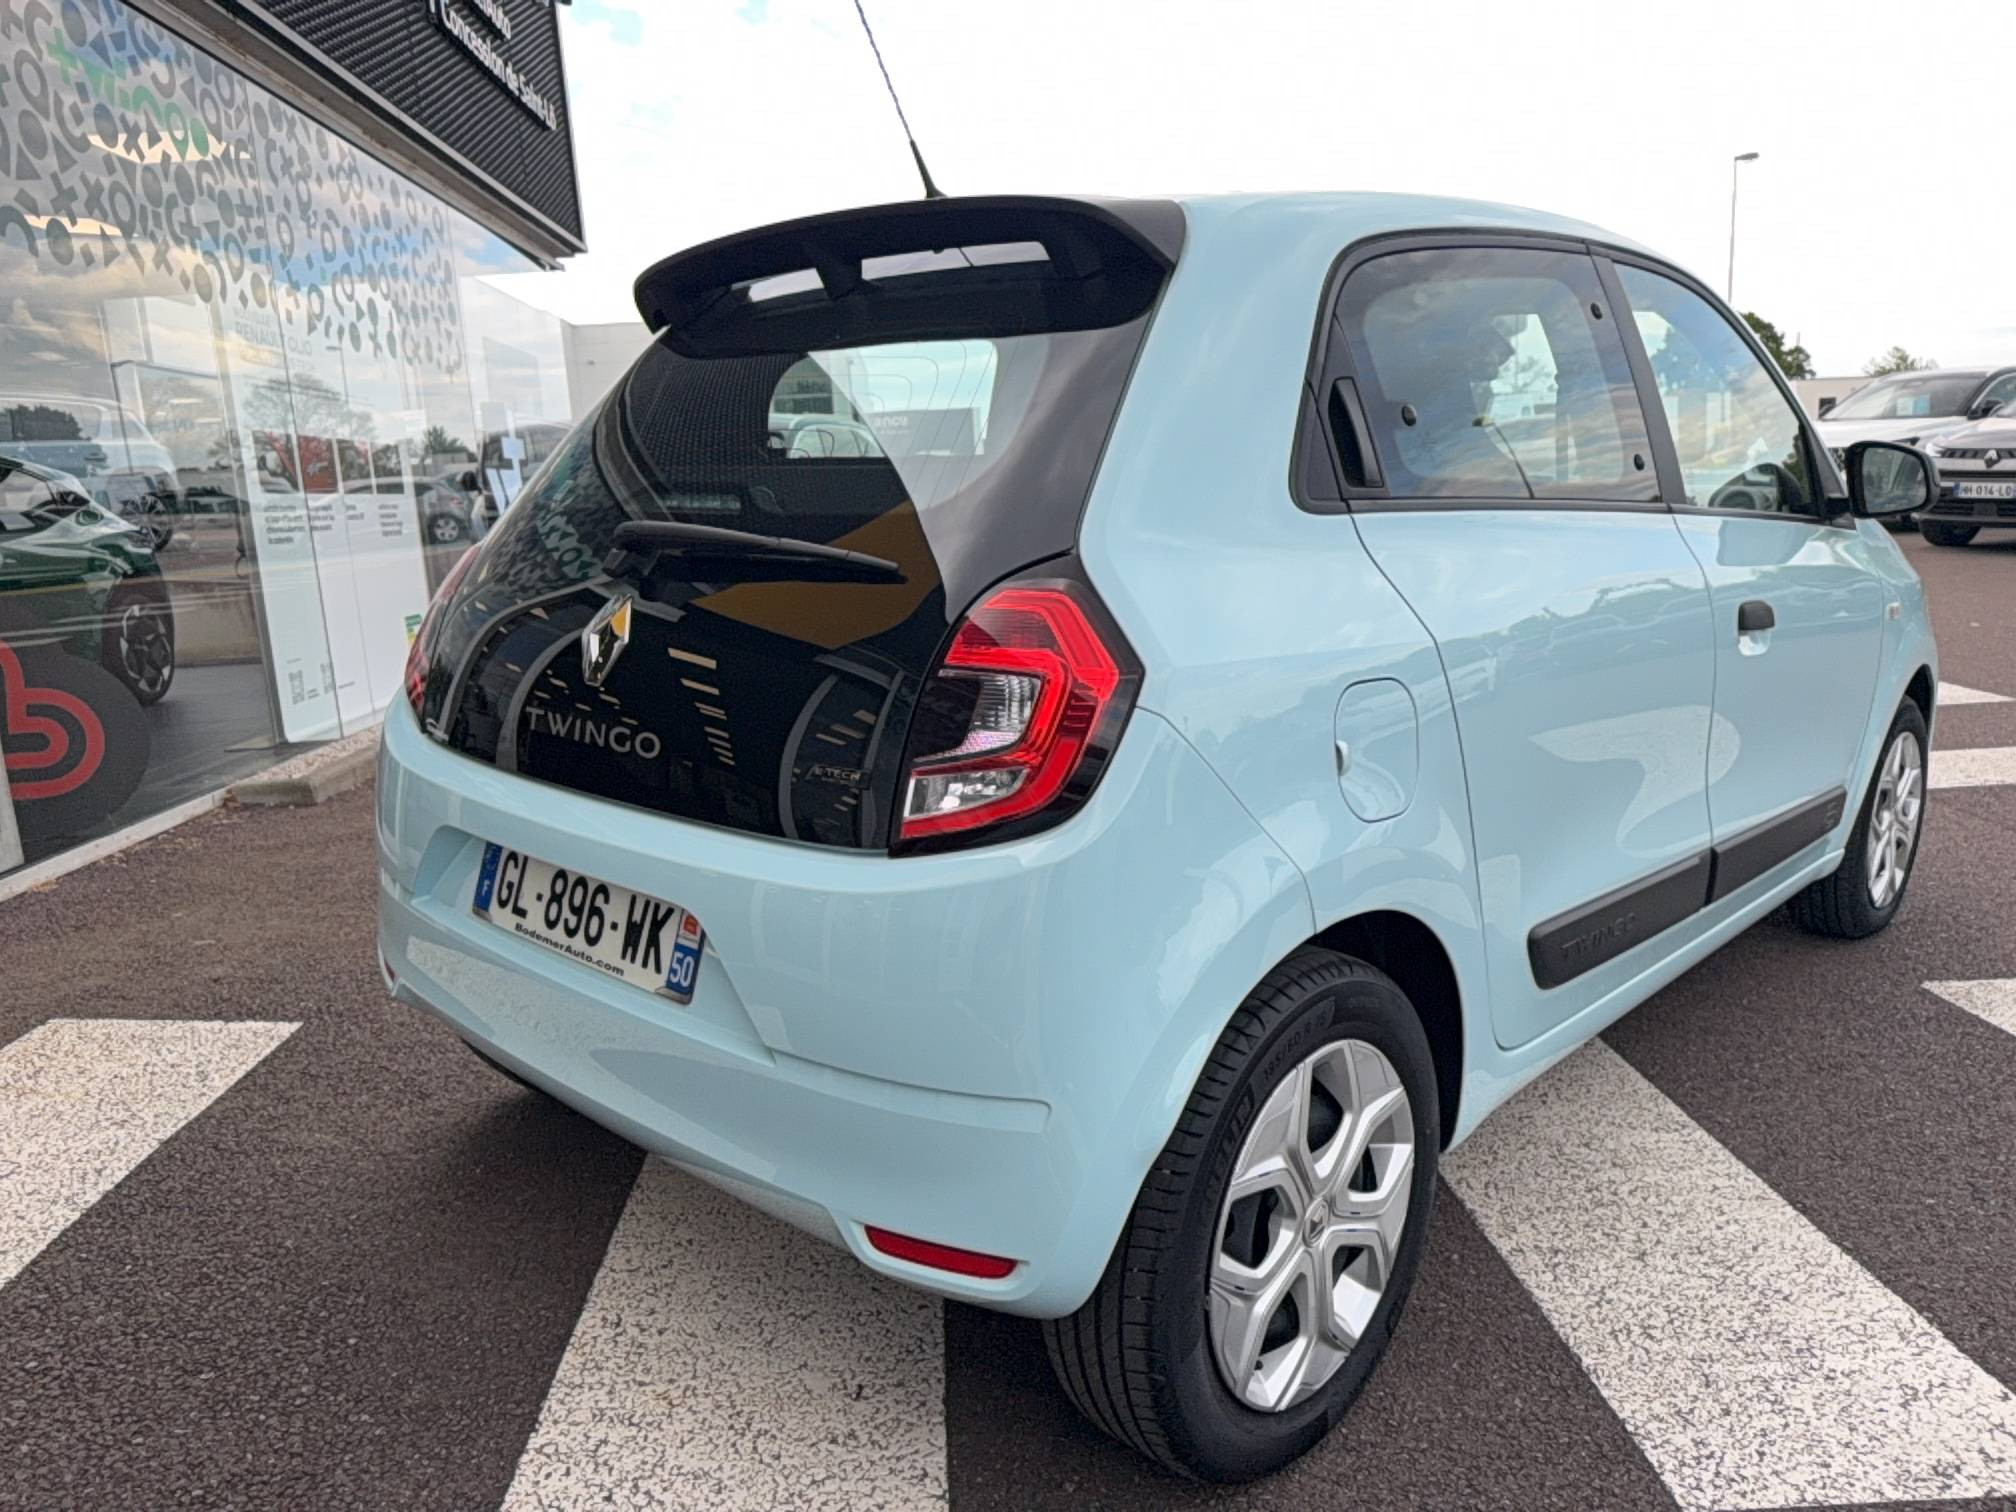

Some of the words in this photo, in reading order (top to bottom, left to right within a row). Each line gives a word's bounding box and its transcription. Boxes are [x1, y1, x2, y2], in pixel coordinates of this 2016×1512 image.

[525, 705, 662, 760] TWINGO
[481, 880, 491, 896] F
[496, 850, 676, 976] GL-896-WK
[514, 922, 625, 978] BodemerAuto.com
[669, 951, 696, 988] 50
